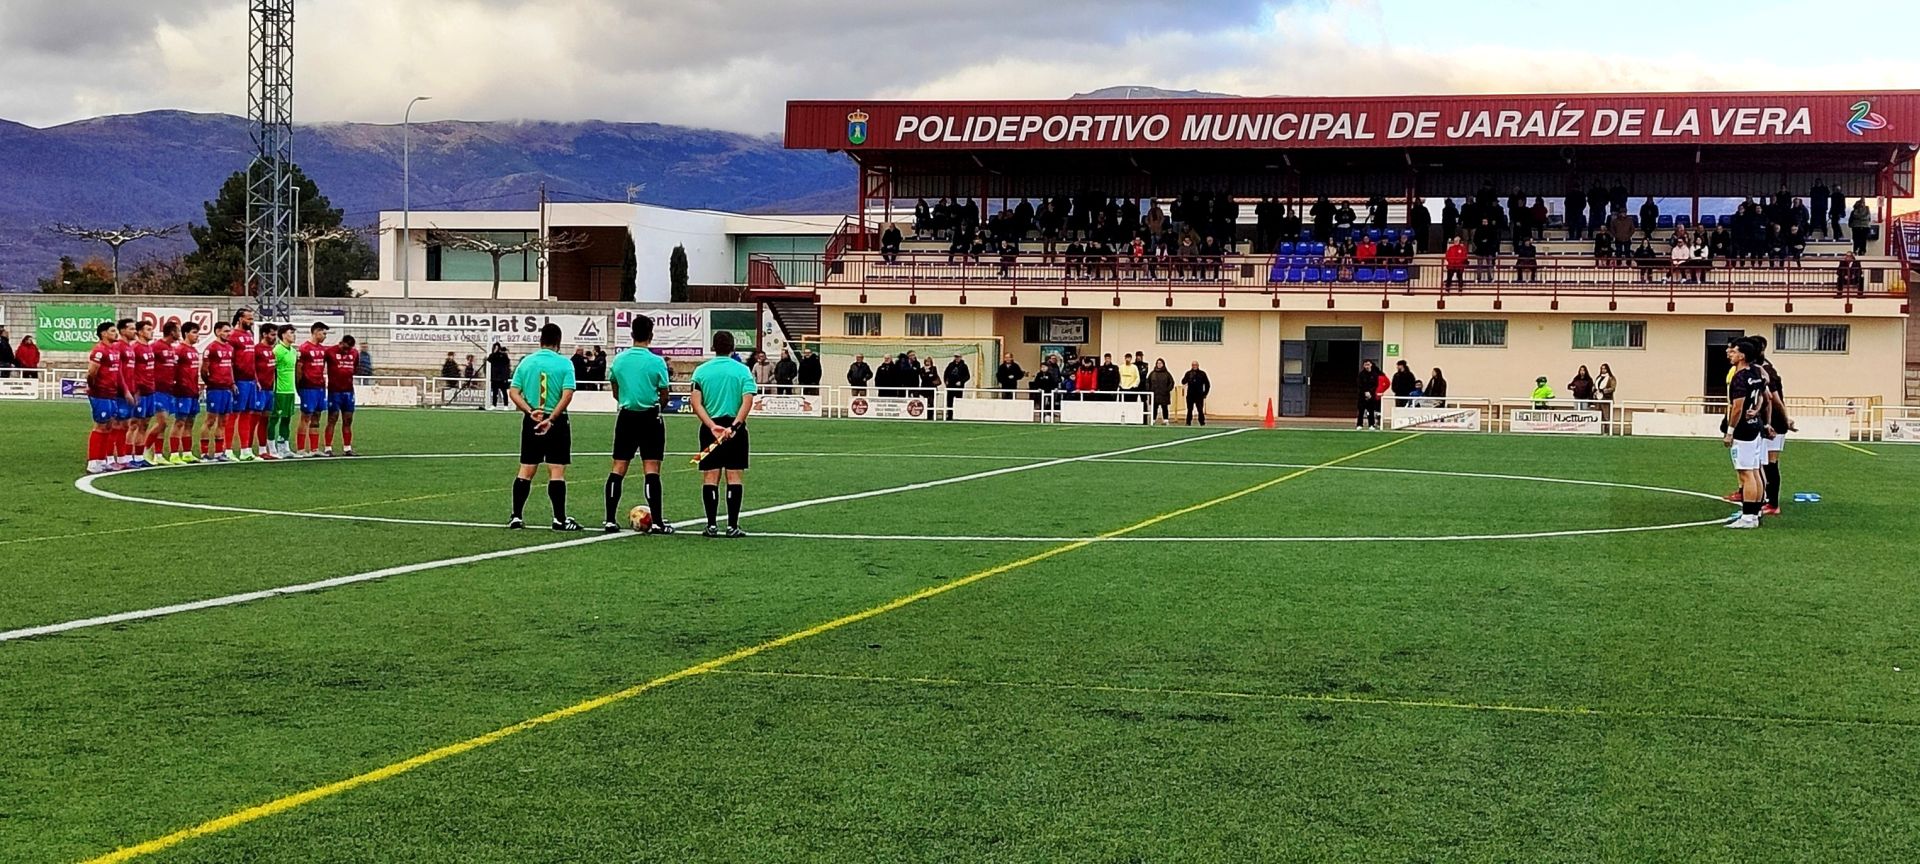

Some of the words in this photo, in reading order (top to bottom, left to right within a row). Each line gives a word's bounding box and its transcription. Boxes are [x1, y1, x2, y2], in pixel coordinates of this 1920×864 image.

[895, 115, 1170, 142] POLIDEPORTIVO
[1181, 112, 1376, 141] MUNICIPAL
[1387, 112, 1441, 139] DE
[1447, 102, 1586, 138] JARAÍZ
[1591, 109, 1646, 137] DE
[1651, 109, 1701, 137] LA
[1711, 107, 1812, 136] VERA
[39, 317, 52, 329] LA
[53, 317, 77, 330] CASA
[78, 318, 92, 330] DE
[396, 314, 438, 331] R&A
[447, 314, 519, 333] Albalat
[650, 313, 702, 330] entality
[53, 330, 100, 343] CARCASAS
[395, 333, 451, 342] EXCAVACIONES
[460, 334, 481, 342] OBRA
[483, 334, 503, 343] CVIL
[507, 334, 520, 343] 927
[522, 334, 531, 342] 46
